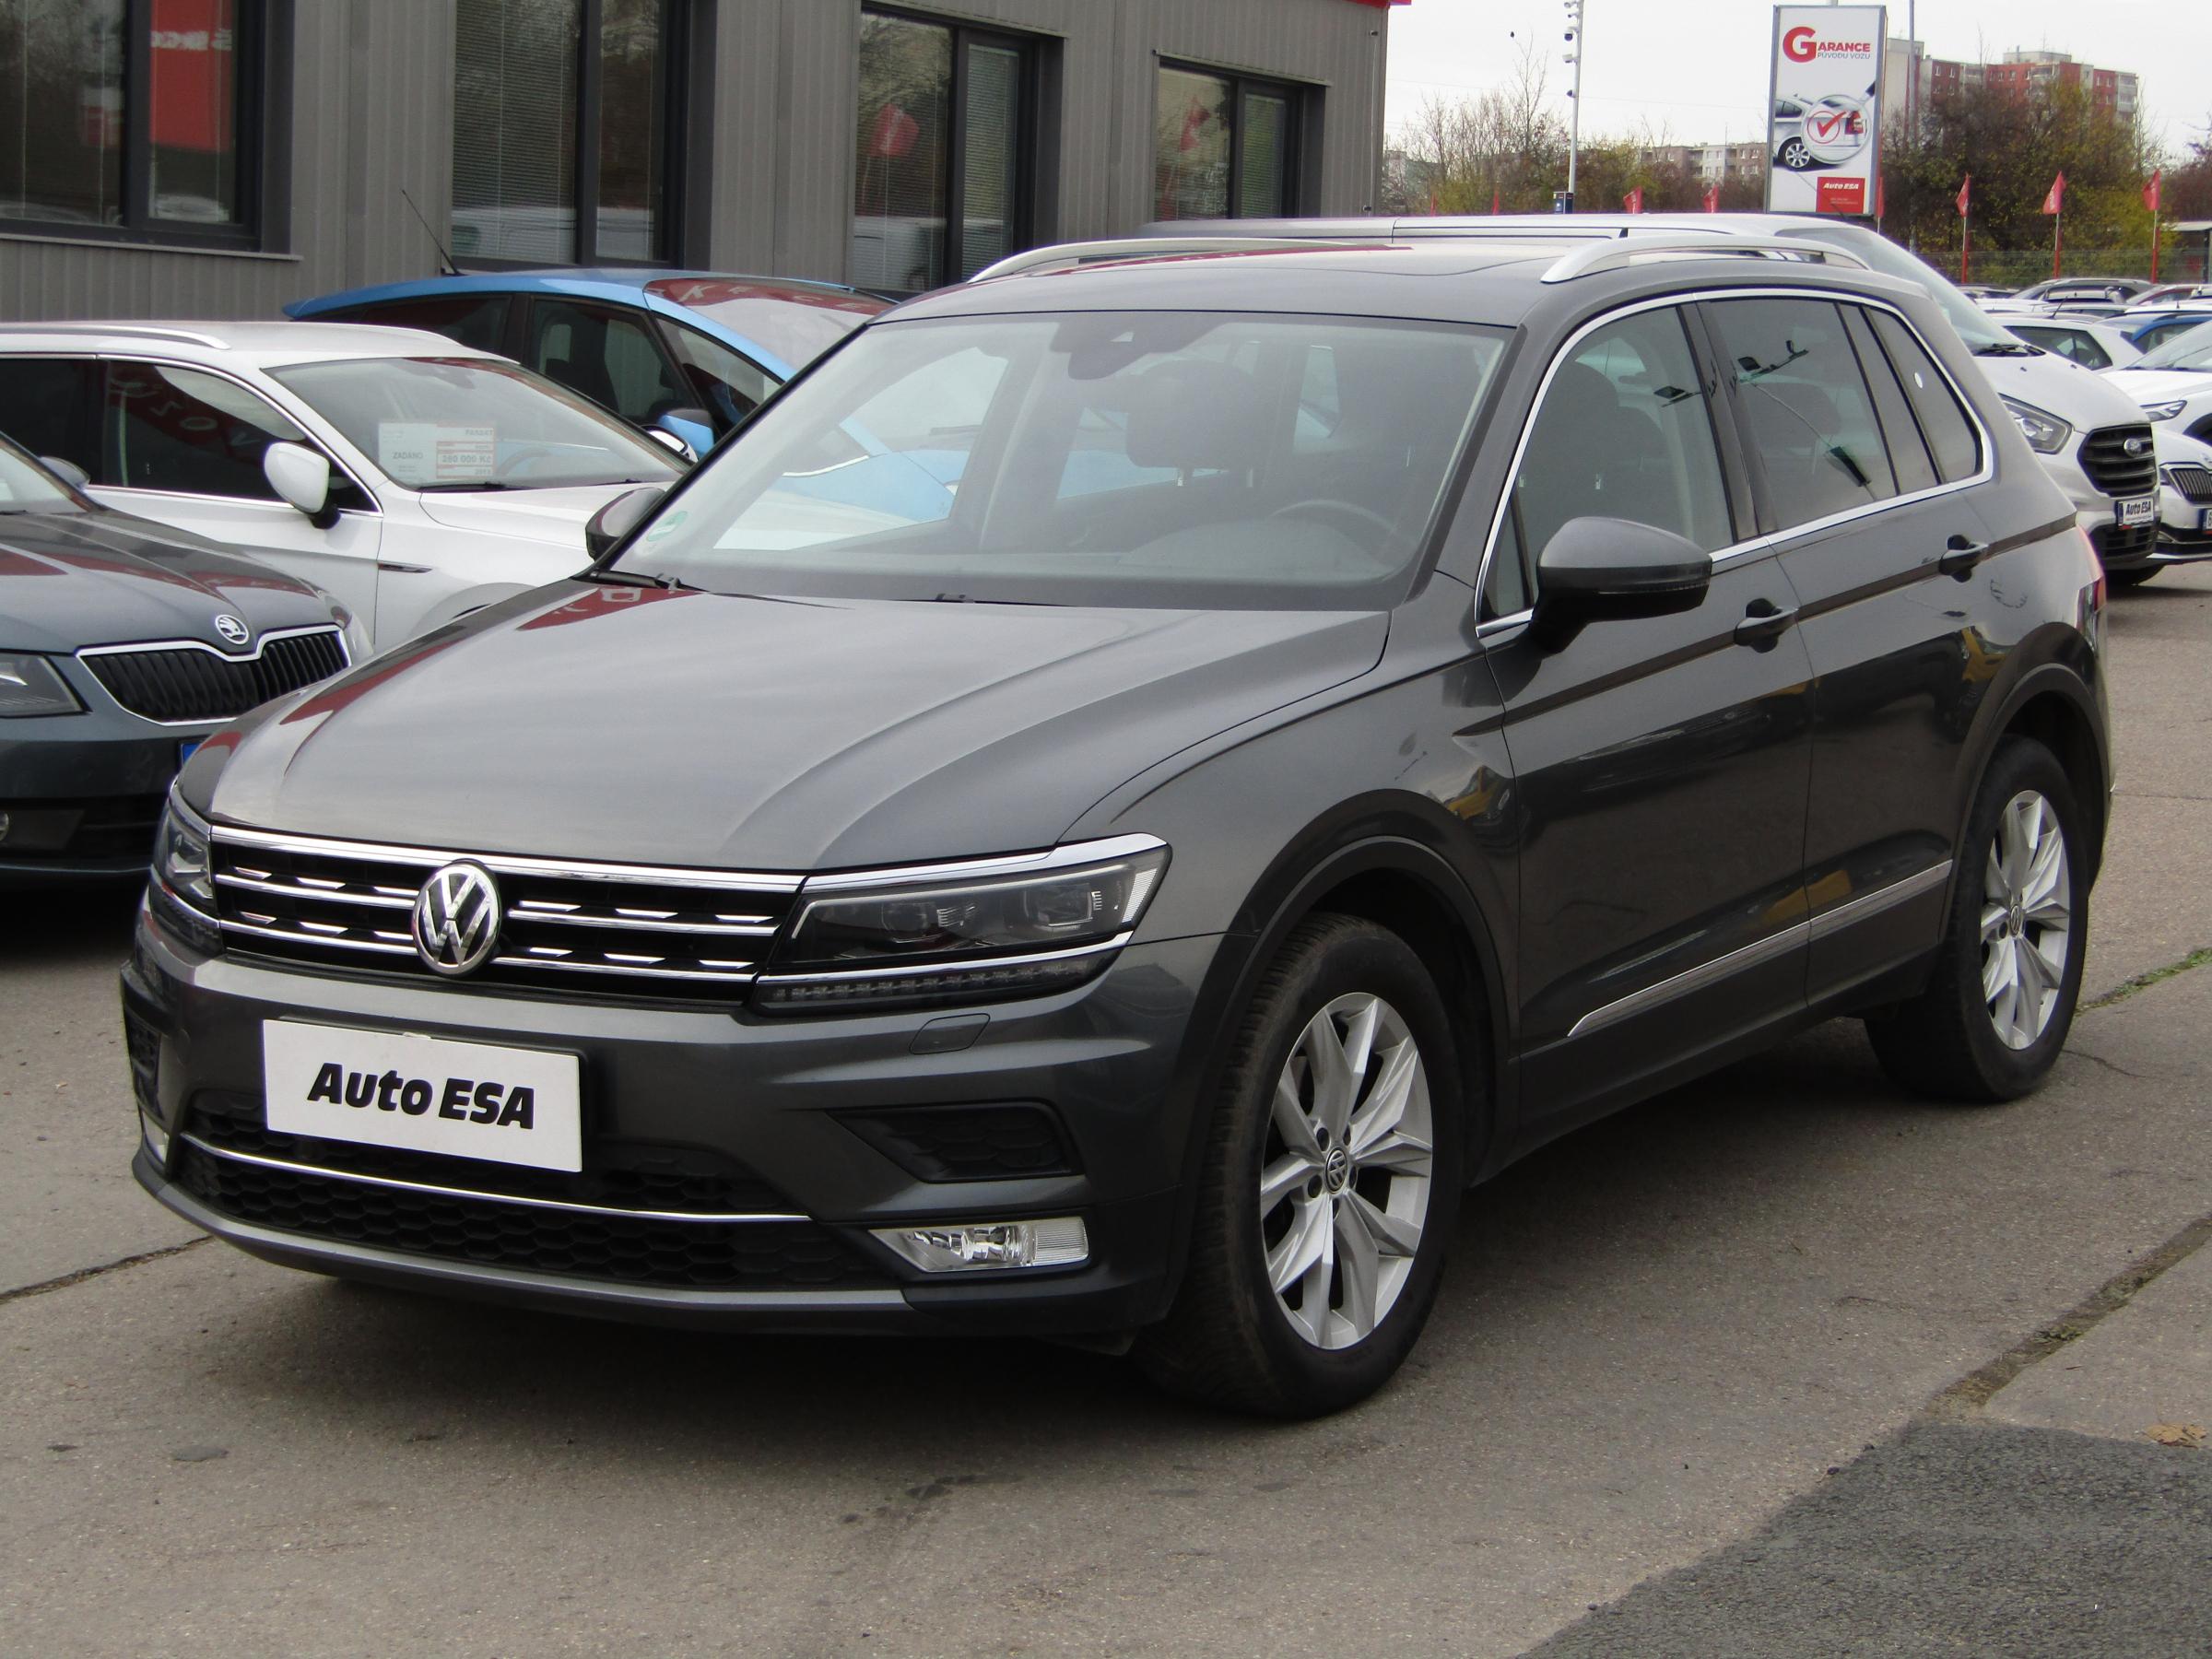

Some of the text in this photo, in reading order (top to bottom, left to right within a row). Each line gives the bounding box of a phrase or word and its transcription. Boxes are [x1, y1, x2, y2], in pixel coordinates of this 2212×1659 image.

[1783, 27, 1871, 63] GARANCE
[307, 1062, 535, 1130] Auto ESA
